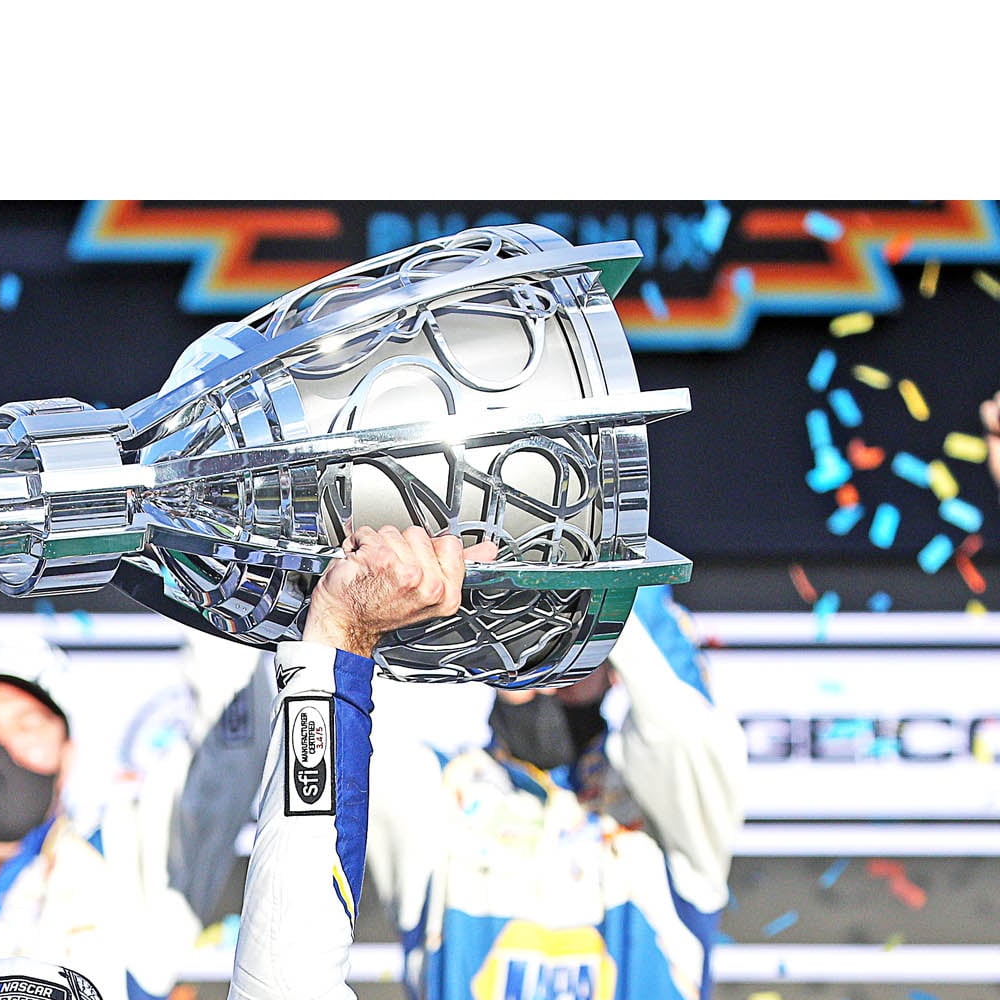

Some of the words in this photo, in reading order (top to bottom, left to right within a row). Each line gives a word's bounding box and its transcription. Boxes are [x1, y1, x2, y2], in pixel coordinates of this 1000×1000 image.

[308, 720, 316, 755] CERTIFIED
[298, 770, 319, 797] sfi
[0, 981, 53, 998] NASCAR
